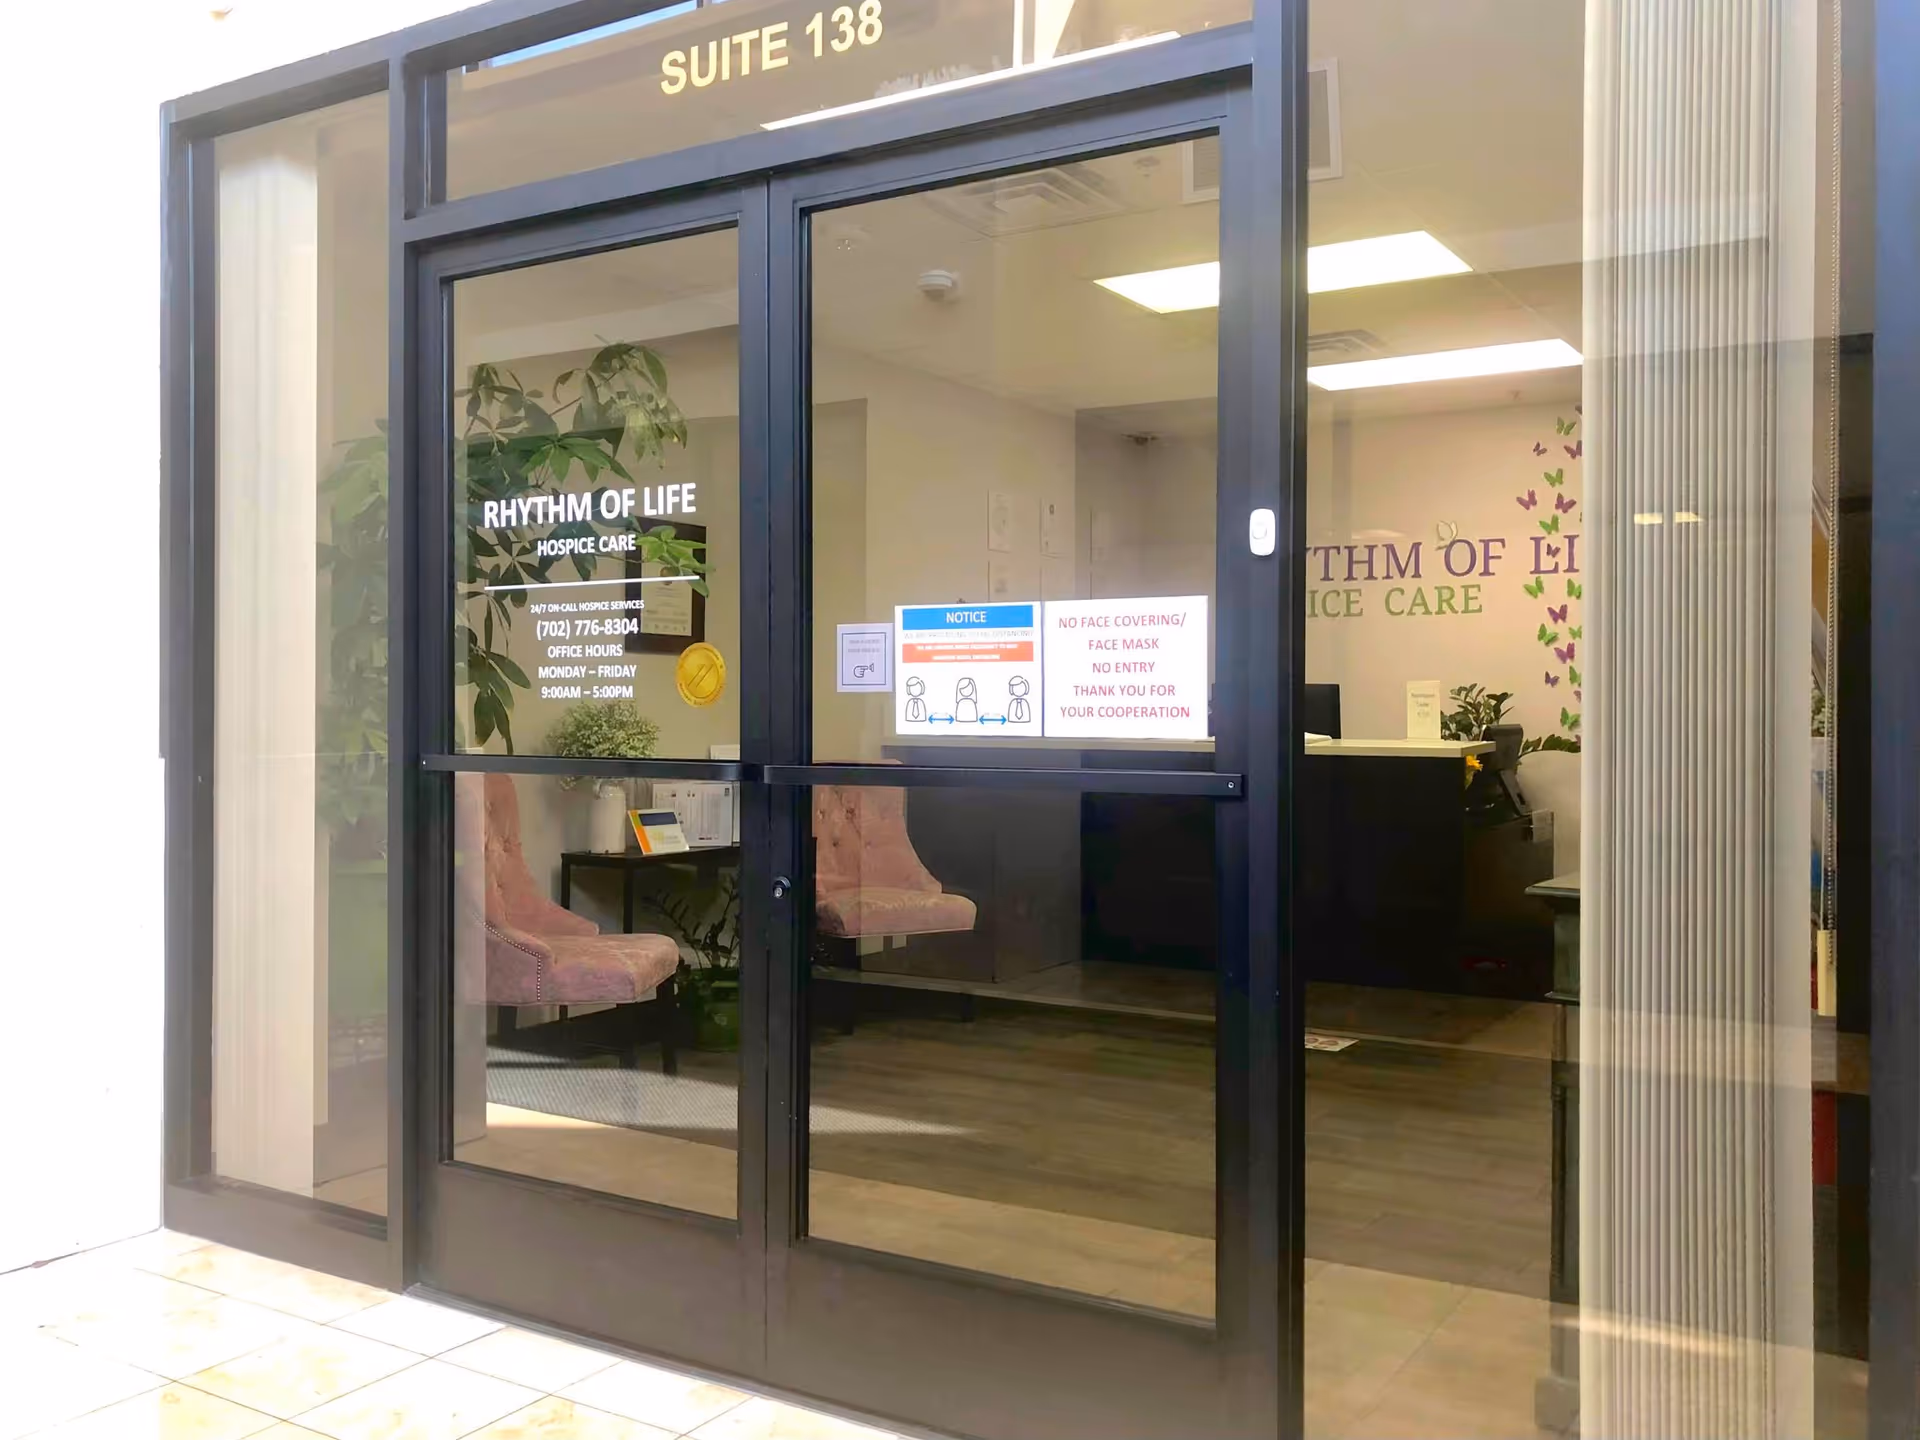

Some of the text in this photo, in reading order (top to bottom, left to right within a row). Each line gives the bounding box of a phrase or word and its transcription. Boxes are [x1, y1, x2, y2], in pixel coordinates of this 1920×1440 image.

[661, 0, 883, 95] SUITE 138
[484, 482, 697, 529] RHYTHM OF LIFE
[537, 534, 637, 556] HOSPICE CARE
[1305, 542, 1422, 581] THM
[1444, 538, 1506, 577] OF
[530, 599, 645, 615] 24/7 ON-CALL HOSPICE SERVICES
[1384, 584, 1482, 616] CARE
[945, 610, 987, 624] NOTICE
[1058, 612, 1187, 629] NO FACE COVERING/
[536, 617, 639, 641] (702) 776-8304
[547, 644, 623, 658] OFFICE HOURS
[1088, 638, 1159, 651] FACE MASK
[538, 665, 587, 679] MONDAY
[598, 664, 637, 678] FRIDAY
[1092, 661, 1156, 674] NO ENTRY
[541, 685, 581, 699] 9:00AM
[592, 685, 634, 698] 5:00PM
[1073, 685, 1176, 697] THANK YOU FOR
[1060, 706, 1190, 718] YOUR COOPERATION
